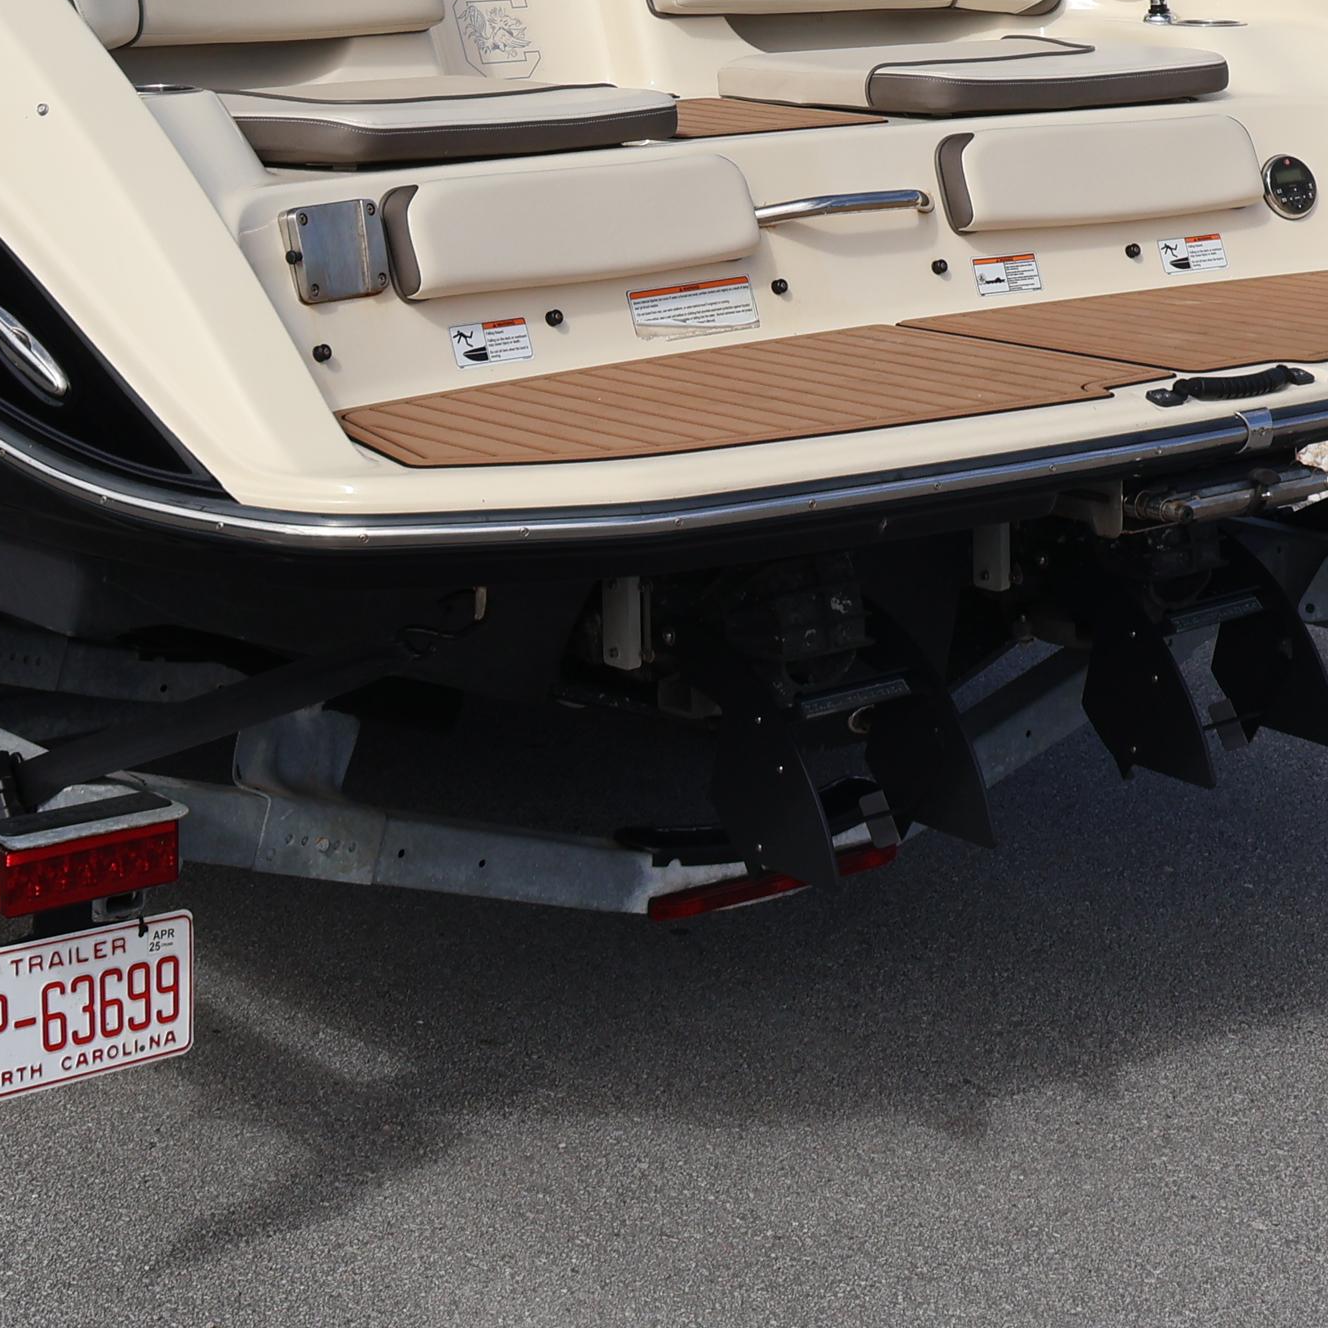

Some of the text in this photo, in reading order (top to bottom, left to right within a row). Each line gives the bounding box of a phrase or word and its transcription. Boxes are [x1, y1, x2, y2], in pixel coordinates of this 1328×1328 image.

[149, 941, 161, 952] 25
[153, 929, 175, 940] APR
[10, 937, 127, 976] TRAILER
[61, 1031, 177, 1071] CAROLINA
